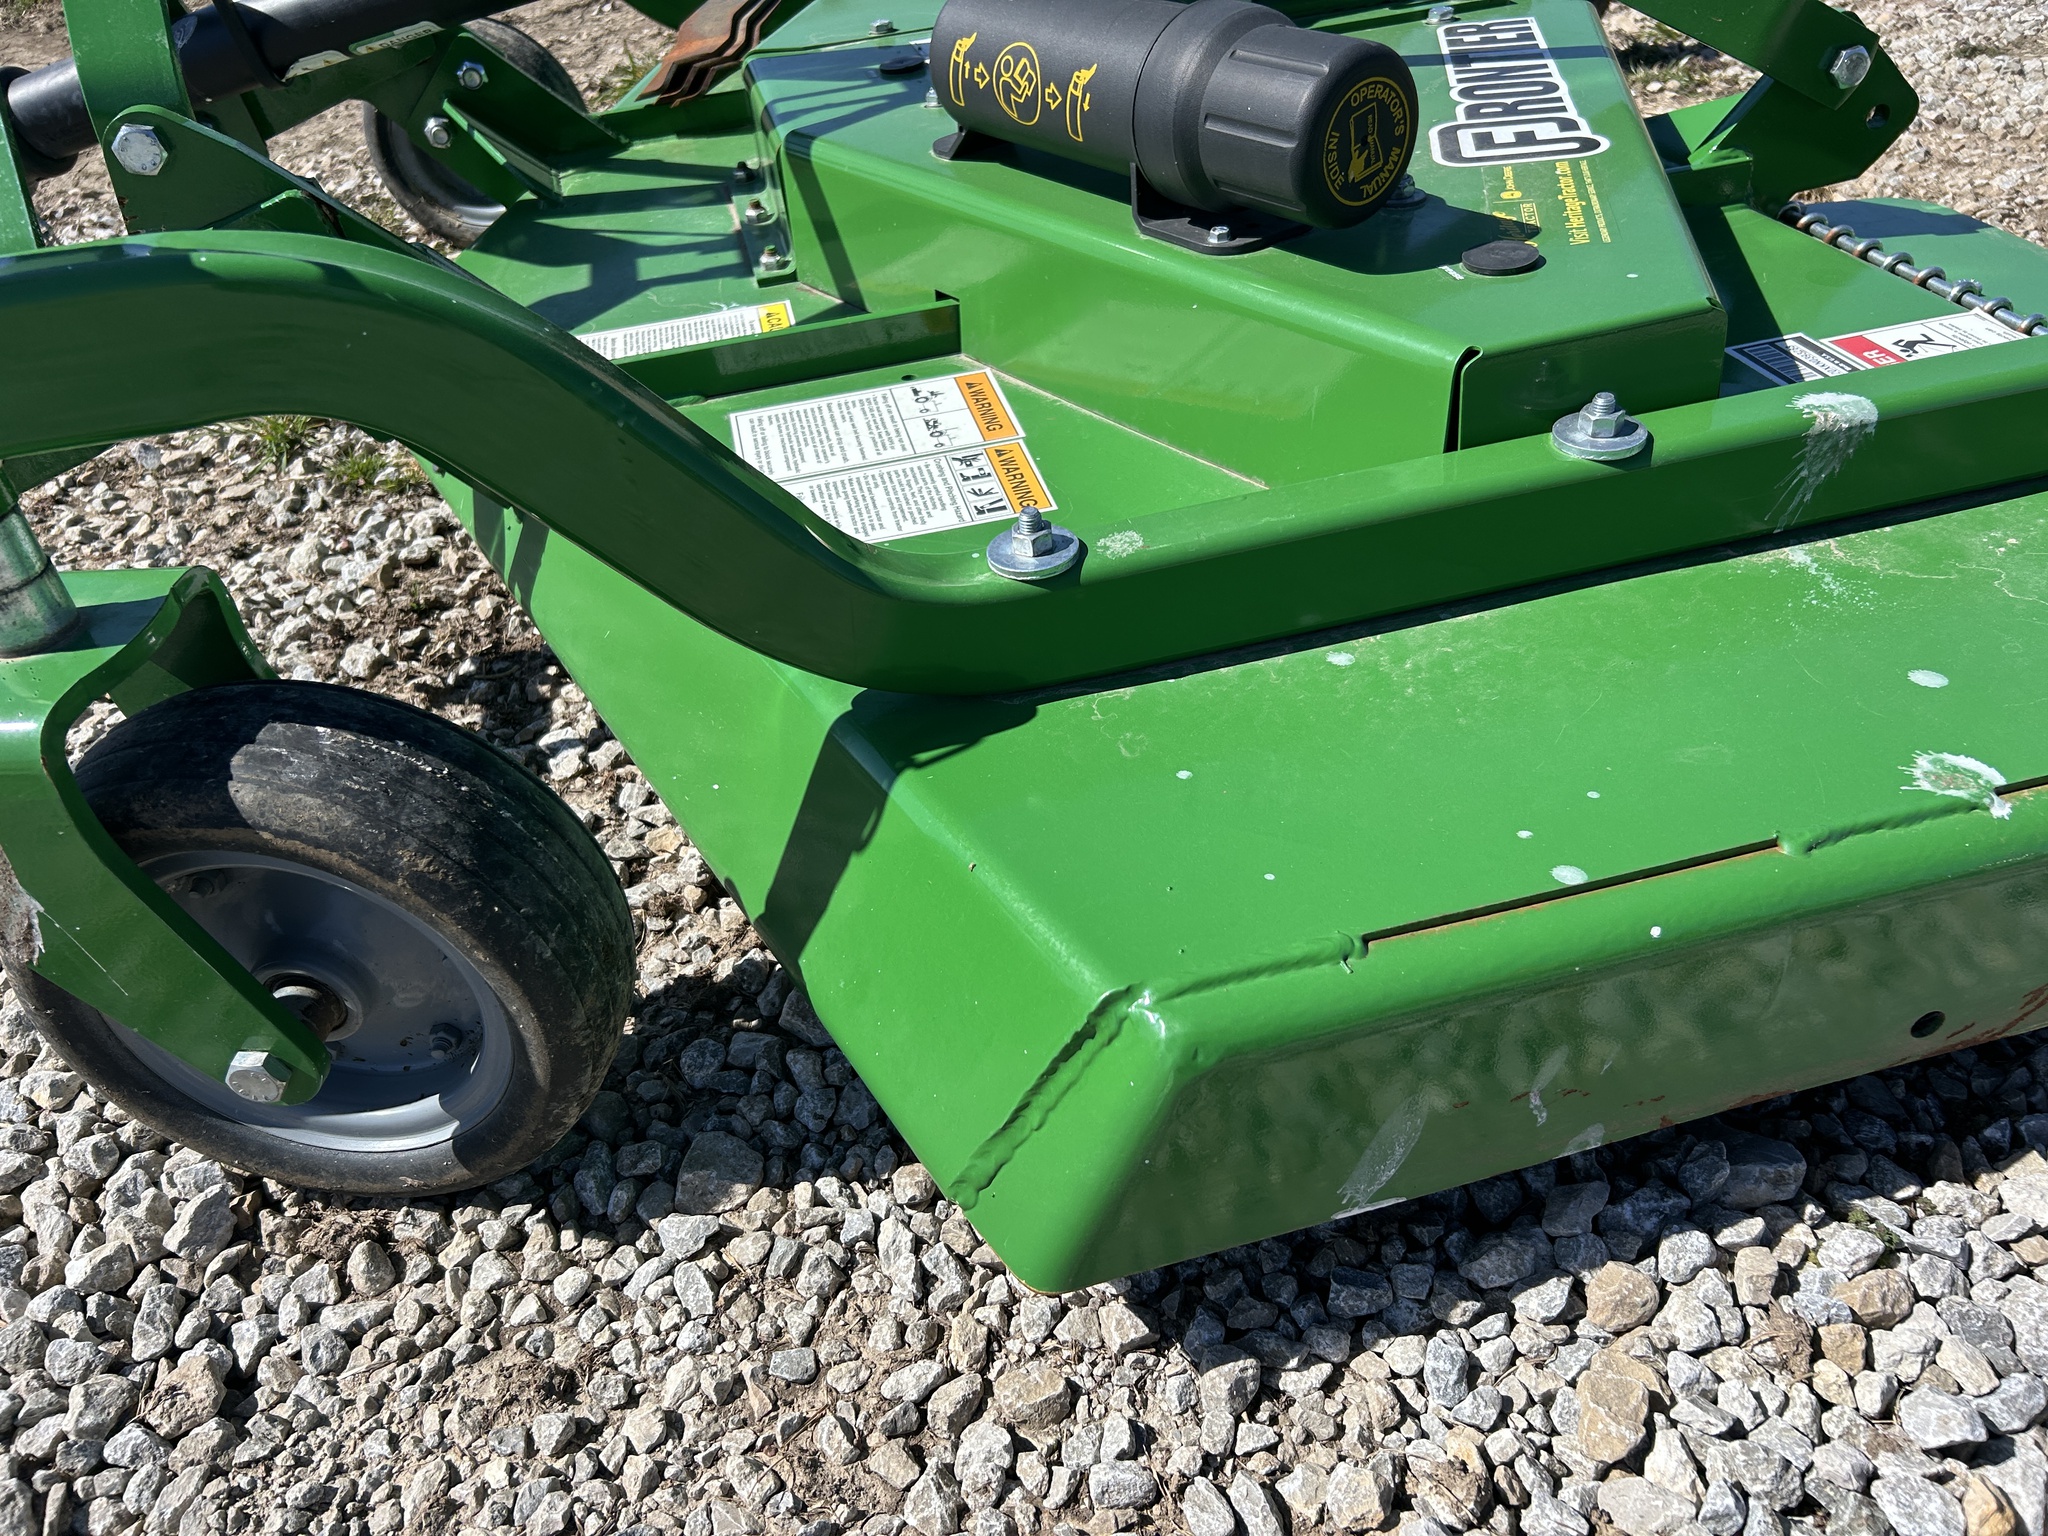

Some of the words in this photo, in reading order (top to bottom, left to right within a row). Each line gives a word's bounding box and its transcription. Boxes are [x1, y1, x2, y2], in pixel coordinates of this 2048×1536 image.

[1351, 84, 1404, 136] OPERATOR'S
[1437, 19, 1601, 163] FRONTIER
[1328, 132, 1344, 190] INSIDE
[1360, 147, 1400, 198] MANUAL
[1555, 161, 1586, 228] HeritageTractor.com
[1522, 202, 1536, 234] TRACTOR
[1568, 228, 1590, 246] Visit
[968, 388, 1004, 432] WARNING
[931, 457, 946, 477] Crushing
[942, 477, 951, 486] and
[998, 456, 1038, 508] WARNING
[945, 486, 958, 506] Pinching
[954, 506, 966, 522] Hazard
